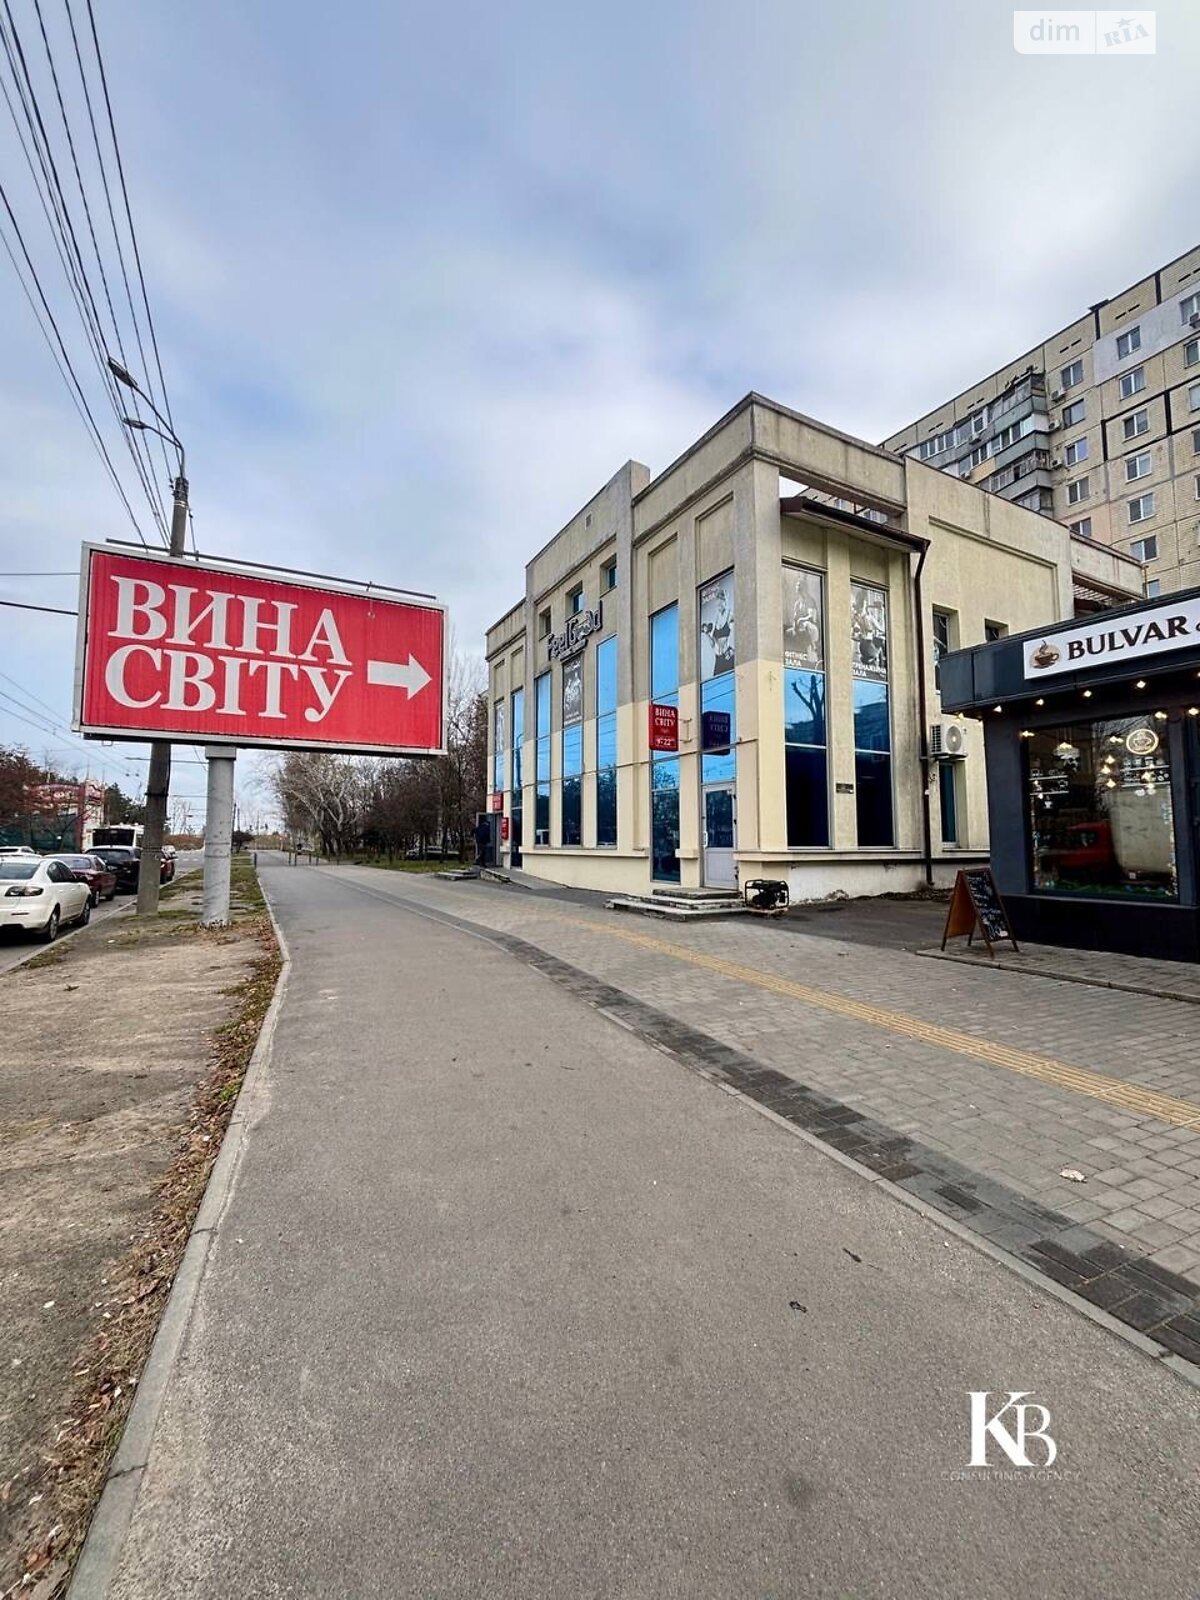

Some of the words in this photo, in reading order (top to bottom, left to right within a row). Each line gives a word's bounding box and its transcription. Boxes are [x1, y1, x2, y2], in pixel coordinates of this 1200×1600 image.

[107, 575, 352, 666] ВИНА
[1067, 615, 1191, 660] BULVAR
[105, 644, 352, 722] СВІТУ
